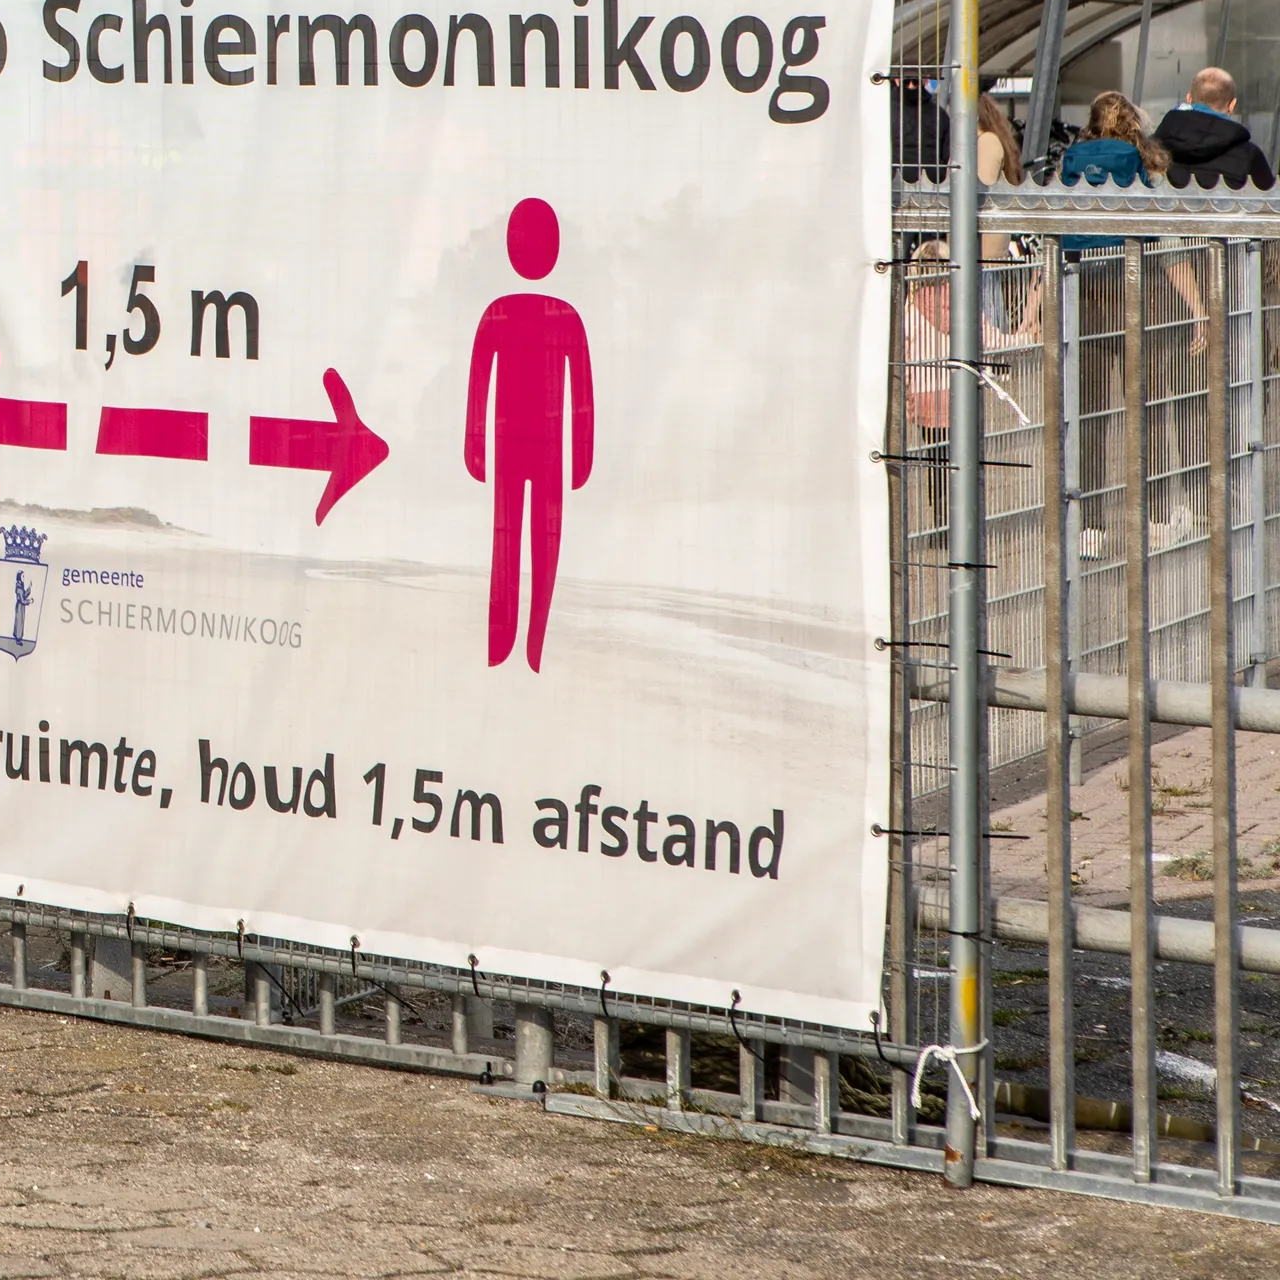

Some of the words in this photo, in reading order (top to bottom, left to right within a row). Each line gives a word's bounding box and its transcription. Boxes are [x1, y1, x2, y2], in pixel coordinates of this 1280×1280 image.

[61, 260, 161, 371] 1,5
[190, 290, 259, 361] m
[62, 568, 144, 589] gemeente
[60, 598, 302, 649] SCHIERMONNIKOOG
[197, 738, 338, 820] houd
[362, 761, 505, 845] 1,5m
[531, 783, 785, 881] afstand
